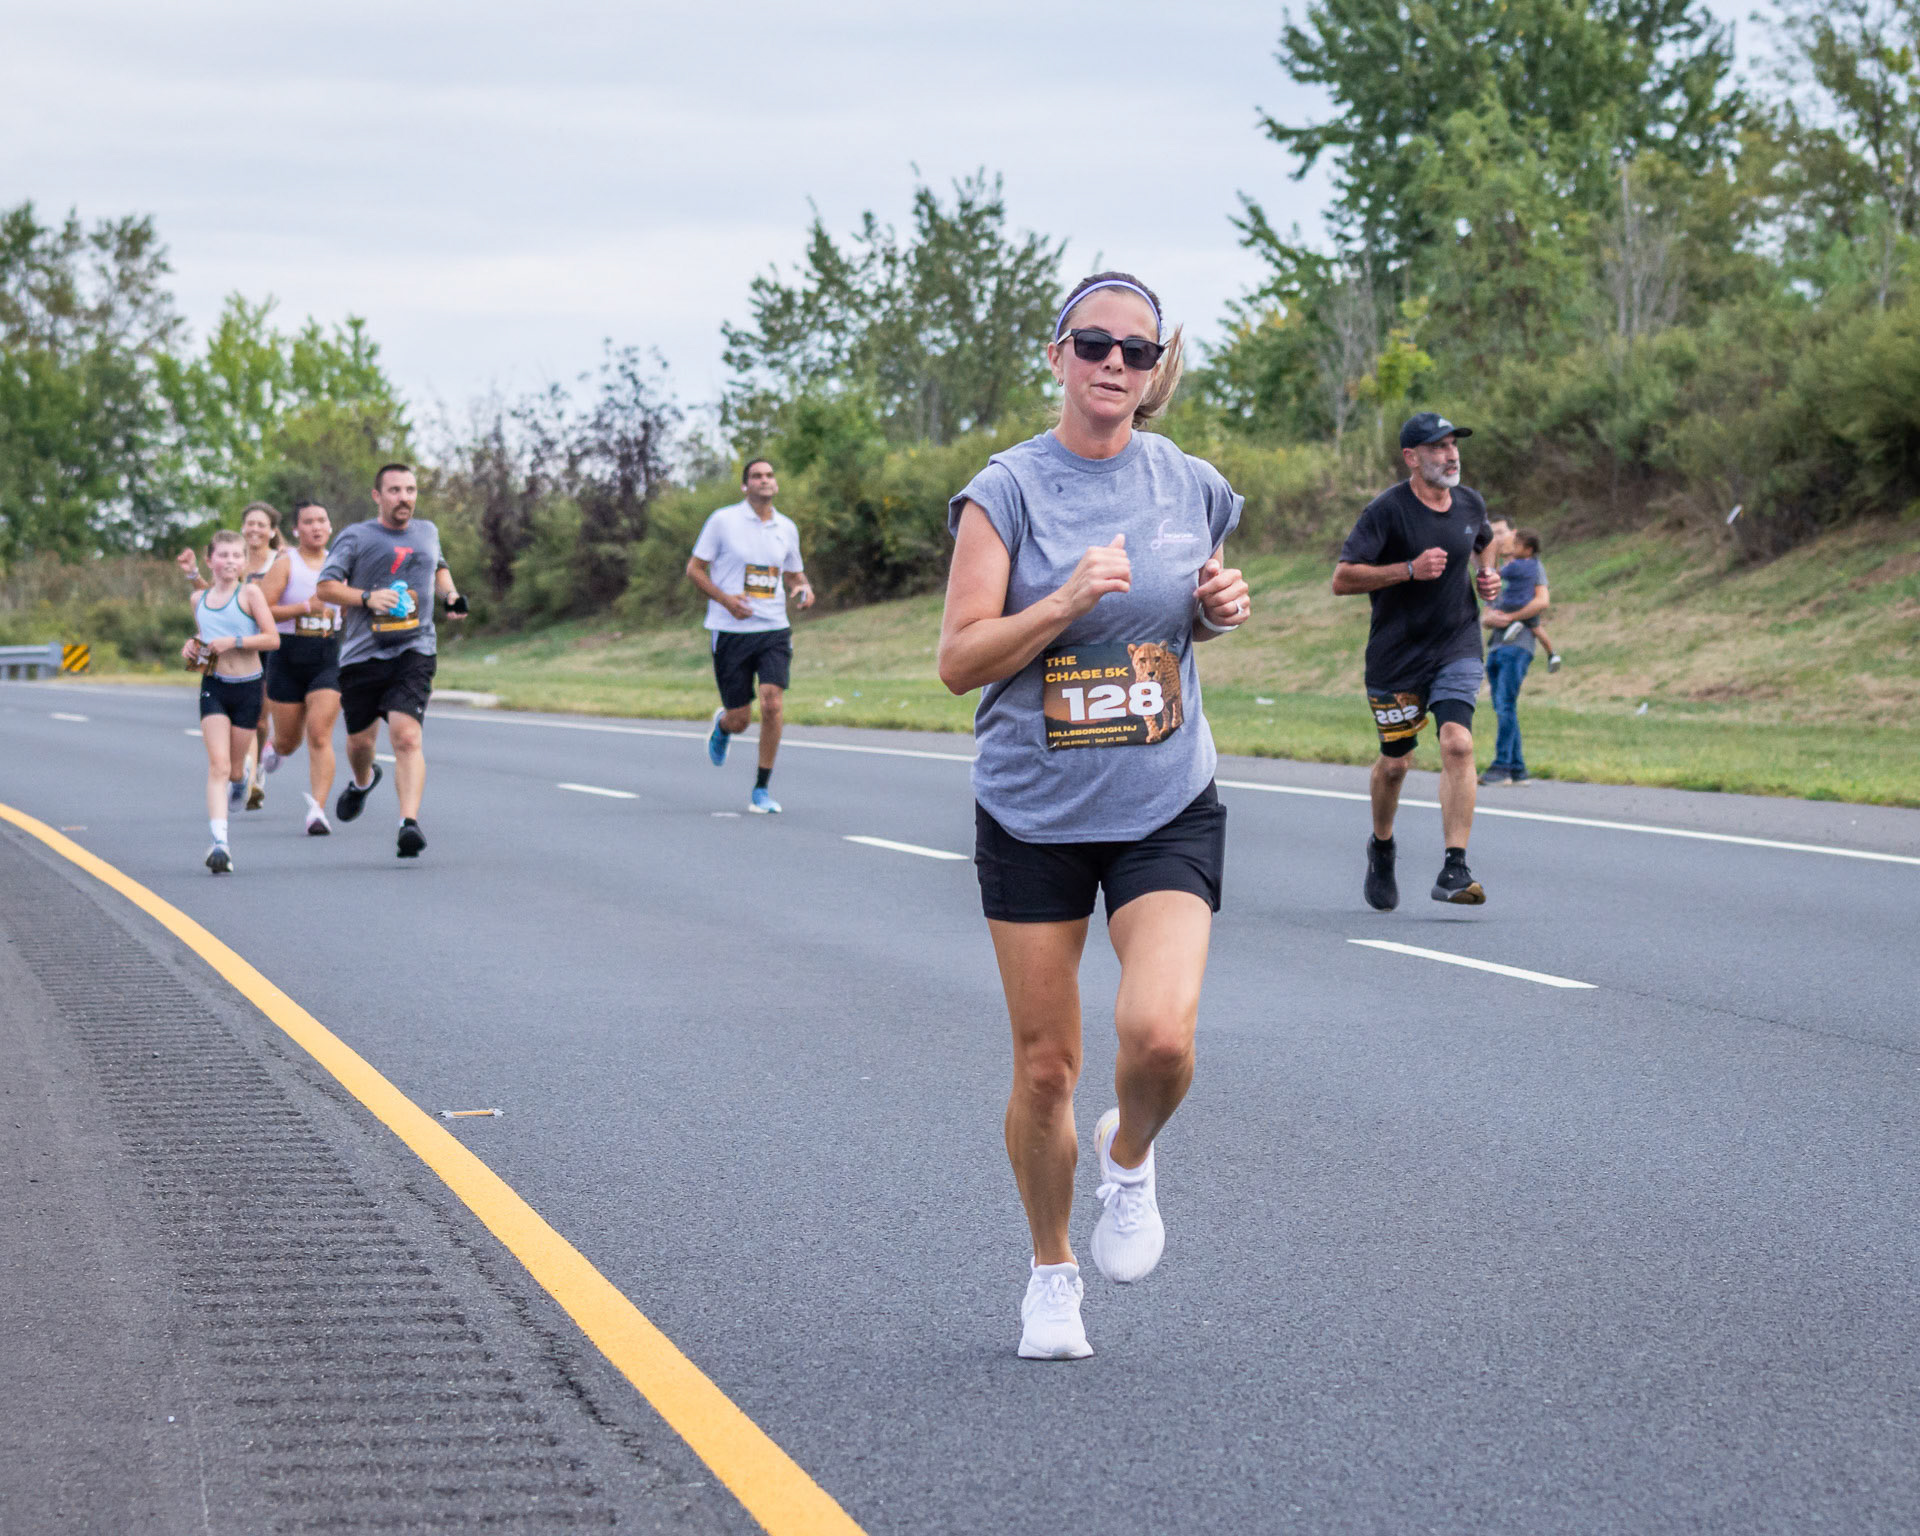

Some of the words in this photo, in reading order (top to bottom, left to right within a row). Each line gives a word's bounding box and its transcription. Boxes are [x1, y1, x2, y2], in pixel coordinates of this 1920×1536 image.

[1046, 655, 1077, 667] THE
[1045, 669, 1102, 683] CHASE
[1104, 666, 1129, 679] 5K
[1061, 681, 1165, 722] 128
[1375, 705, 1420, 725] 282
[1122, 724, 1137, 732] NJ
